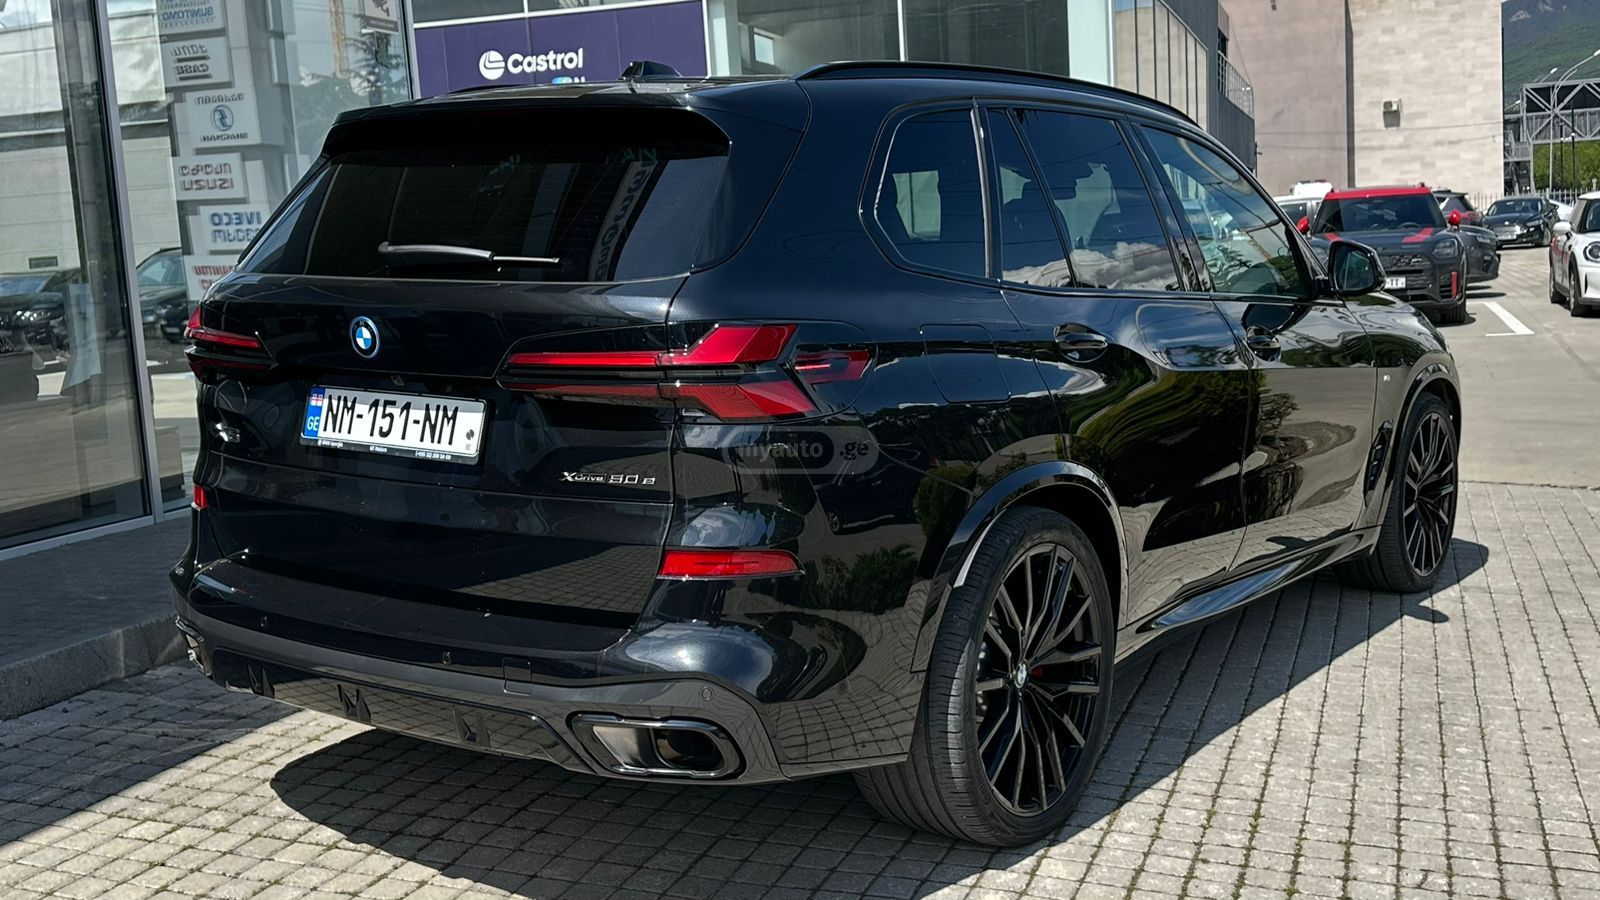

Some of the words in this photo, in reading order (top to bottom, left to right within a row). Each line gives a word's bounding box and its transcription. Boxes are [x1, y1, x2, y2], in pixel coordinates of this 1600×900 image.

[507, 47, 583, 74] Castrol
[307, 416, 319, 431] GE
[323, 395, 459, 446] NM-151-NM
